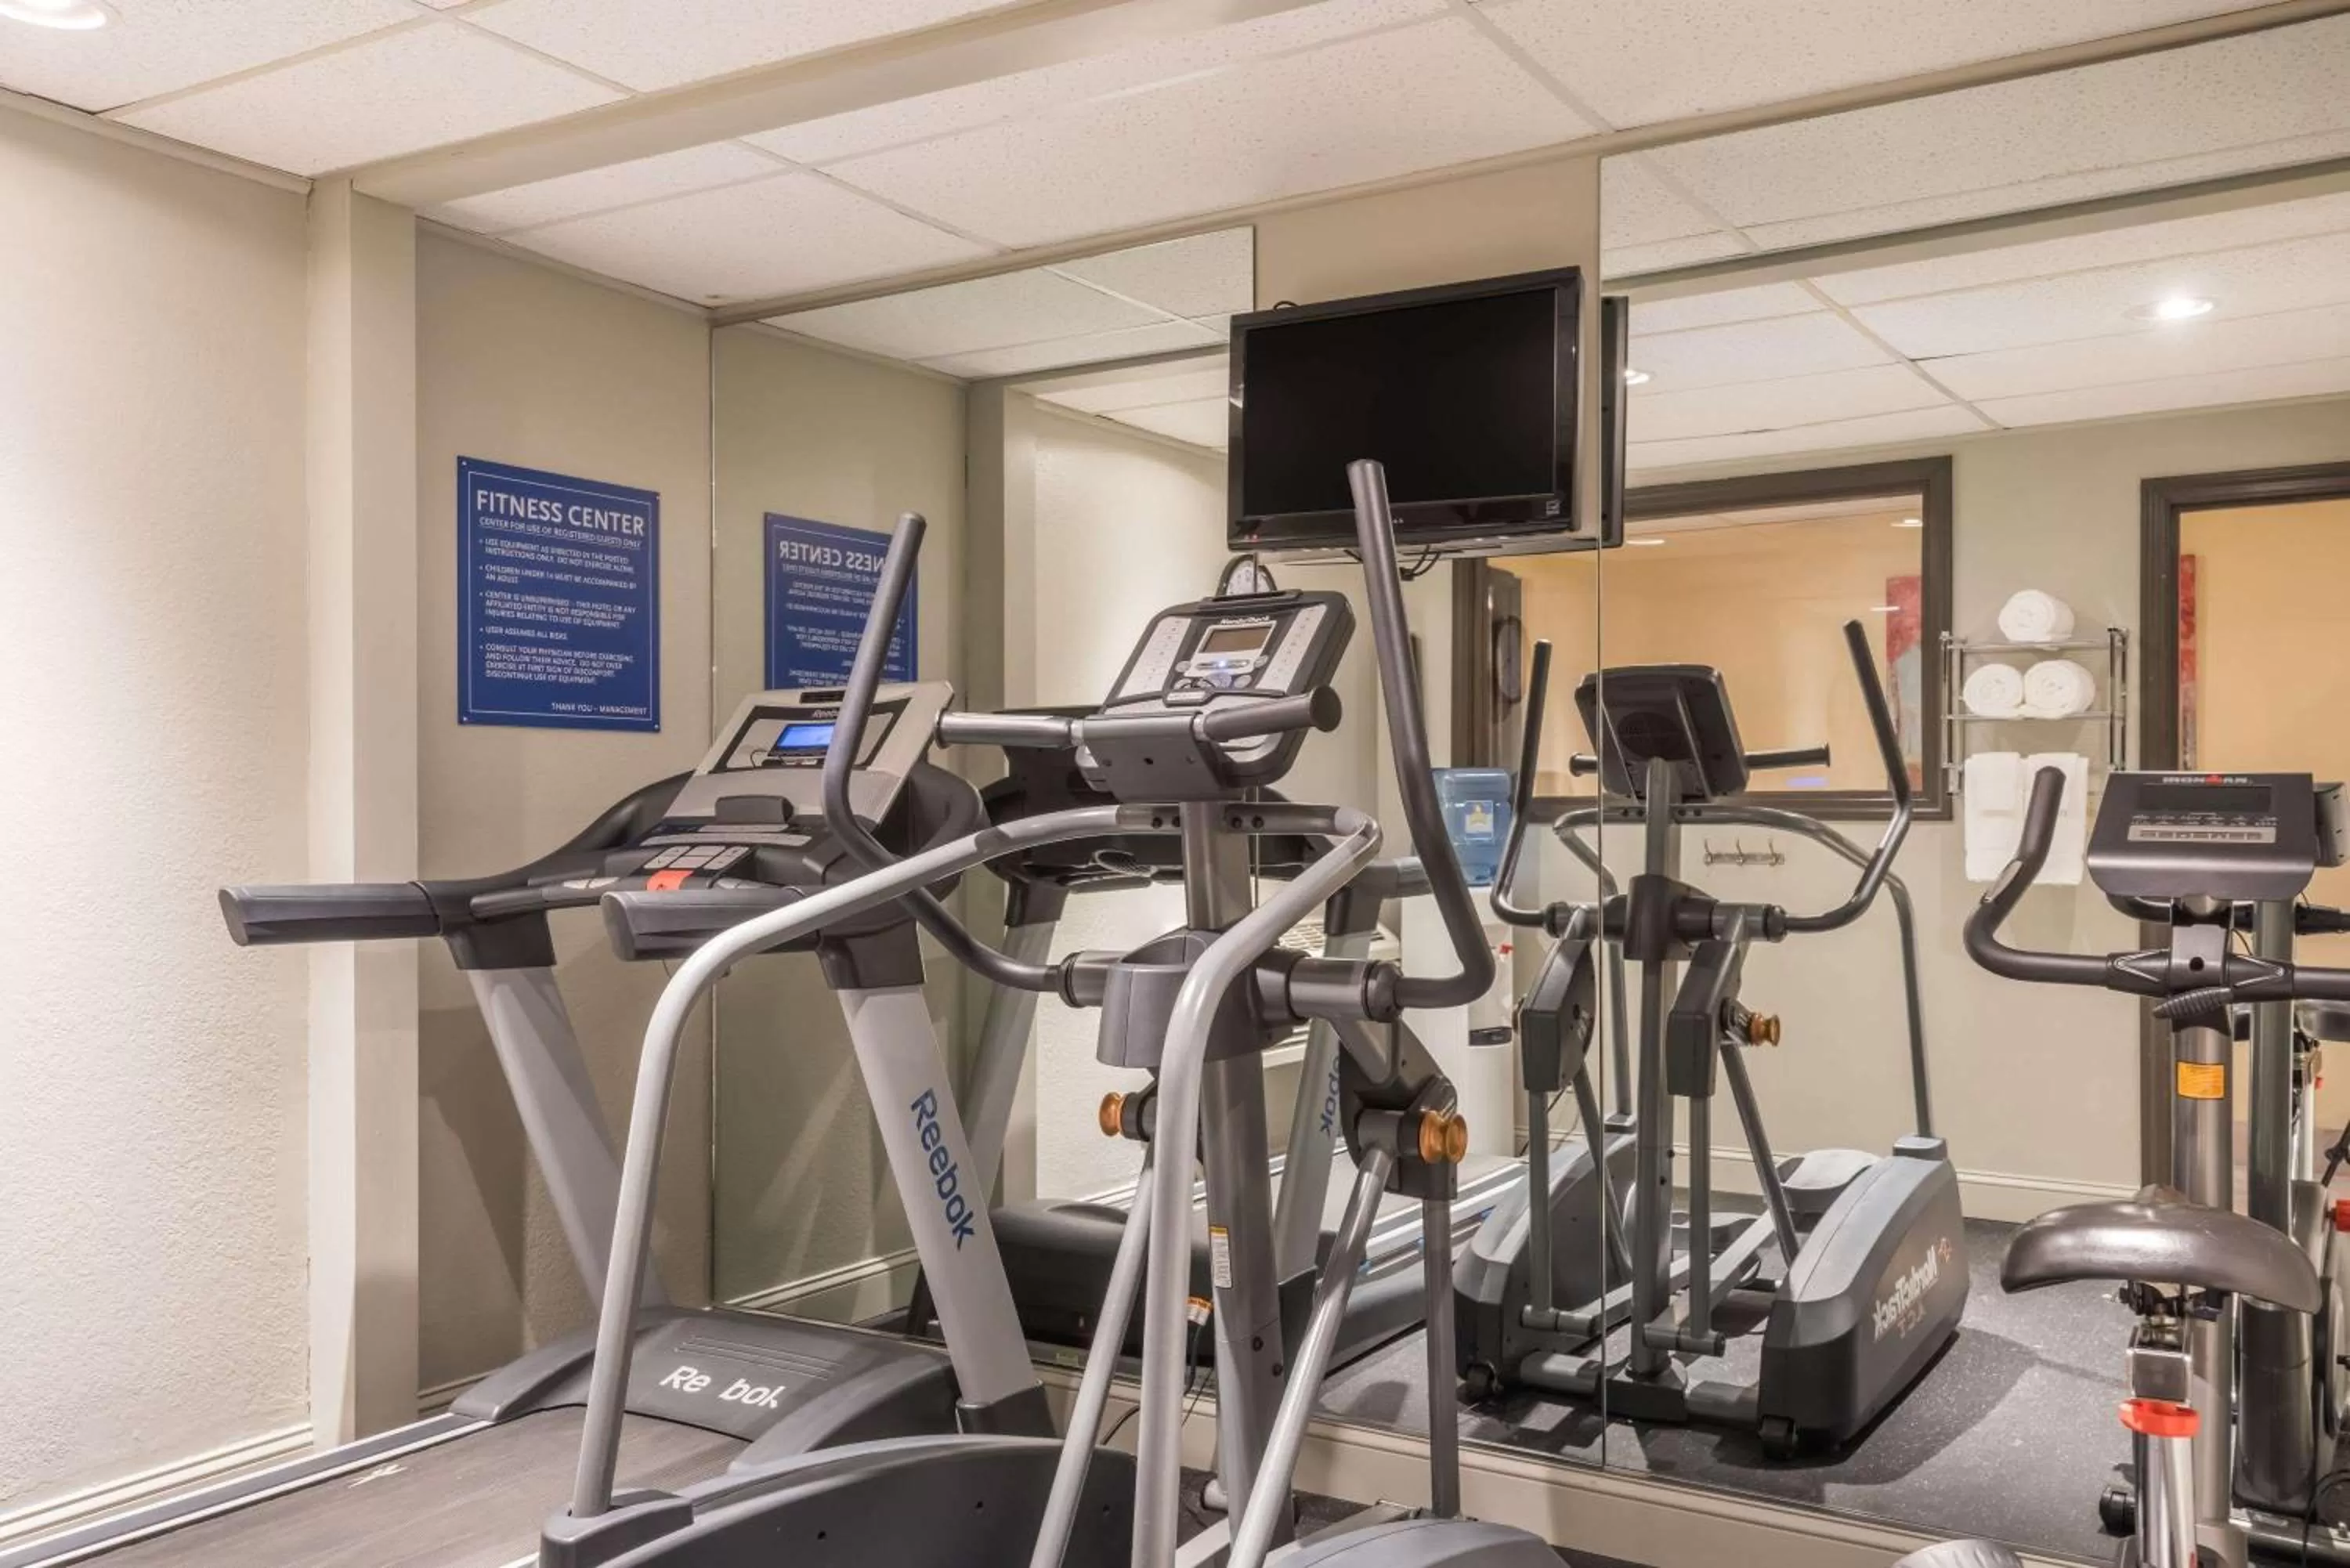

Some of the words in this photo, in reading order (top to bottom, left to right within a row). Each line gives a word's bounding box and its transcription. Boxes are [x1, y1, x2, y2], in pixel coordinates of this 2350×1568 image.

[476, 489, 562, 523] FITNESS
[569, 504, 644, 536] CENTER
[599, 705, 645, 714] MANAGEMENT
[911, 1088, 975, 1251] Reebok
